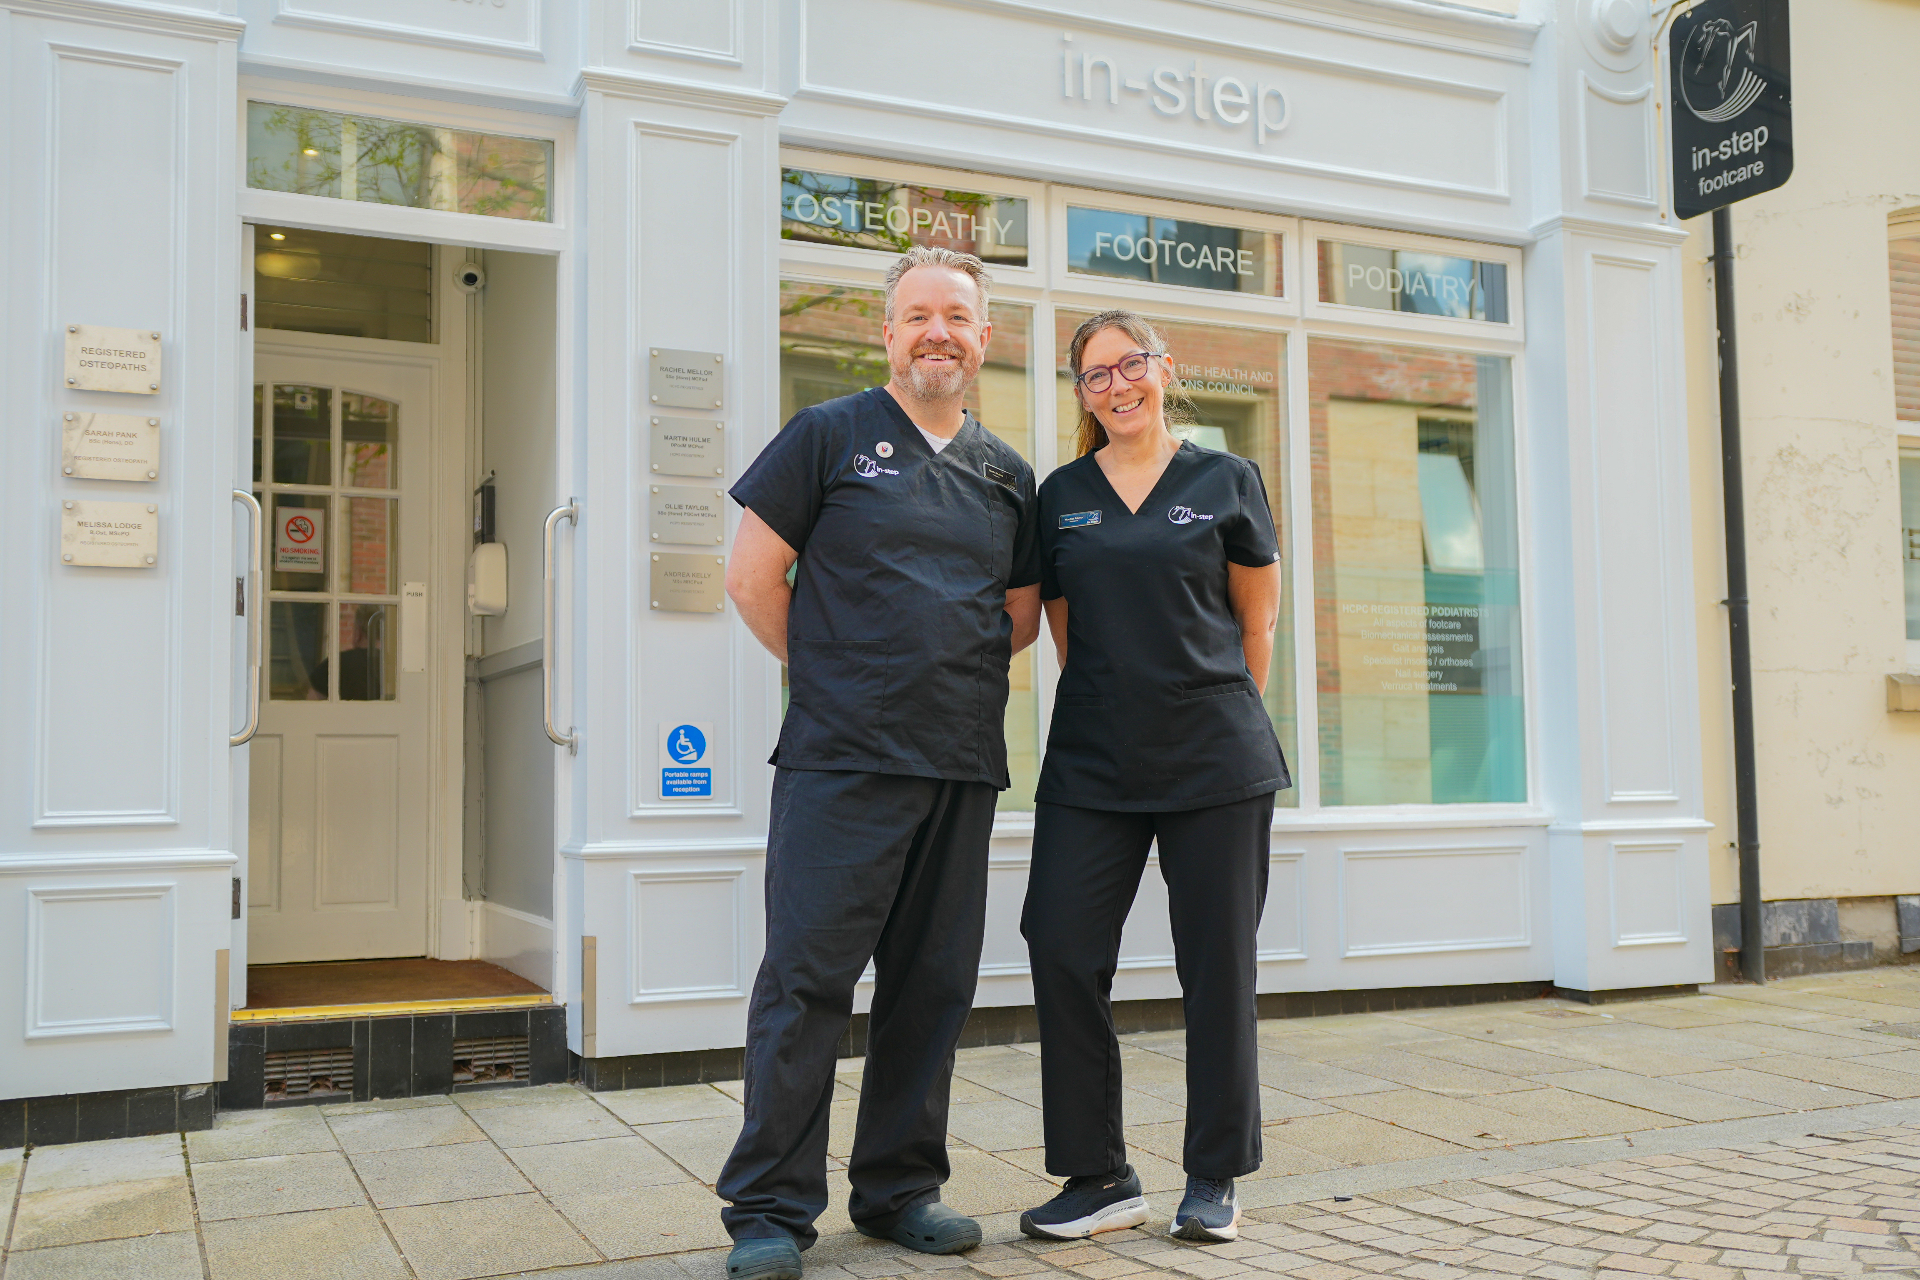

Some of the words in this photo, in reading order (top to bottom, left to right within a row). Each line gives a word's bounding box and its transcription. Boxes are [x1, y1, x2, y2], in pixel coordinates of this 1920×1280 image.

[1063, 32, 1291, 145] in-step
[1692, 125, 1769, 172] in-step
[1698, 160, 1764, 196] footcare
[794, 193, 1013, 245] OSTEOPATHY
[1095, 231, 1254, 276] FOOTCARE
[1348, 263, 1475, 301] PODIATRY
[81, 346, 146, 359] REGISTERED
[79, 359, 147, 372] OSTEOPATHS
[660, 366, 686, 374] RACHEL
[687, 368, 713, 376] MELLOR
[1178, 363, 1201, 376] THE
[1204, 366, 1248, 380] HEALTH
[1250, 370, 1274, 383] AND
[1207, 381, 1257, 396] COUNCIL
[84, 429, 114, 437] SARAH
[115, 431, 138, 439] PANK
[663, 434, 688, 442] MARTIN
[77, 520, 112, 529] MELISSA
[114, 522, 142, 530] LODGE
[1342, 604, 1369, 614] HCPC
[1371, 604, 1429, 616] REGISTERED
[1431, 606, 1490, 618] PODIATRISTS
[1373, 618, 1384, 627] All
[1386, 619, 1417, 629] aspects
[1420, 618, 1427, 627] of
[1429, 618, 1461, 630] footcare
[1361, 630, 1421, 640] Biomechanical
[1421, 632, 1473, 642] assessments
[1392, 643, 1410, 653] Gait
[1413, 644, 1445, 656] analysis
[1363, 655, 1402, 666] Specialist
[1404, 656, 1432, 666] insoles
[1439, 657, 1473, 667] orthoses
[1395, 668, 1411, 678] Nail
[1413, 670, 1443, 681] surgery
[1381, 681, 1413, 691] Verruca
[1415, 681, 1458, 692] treatments
